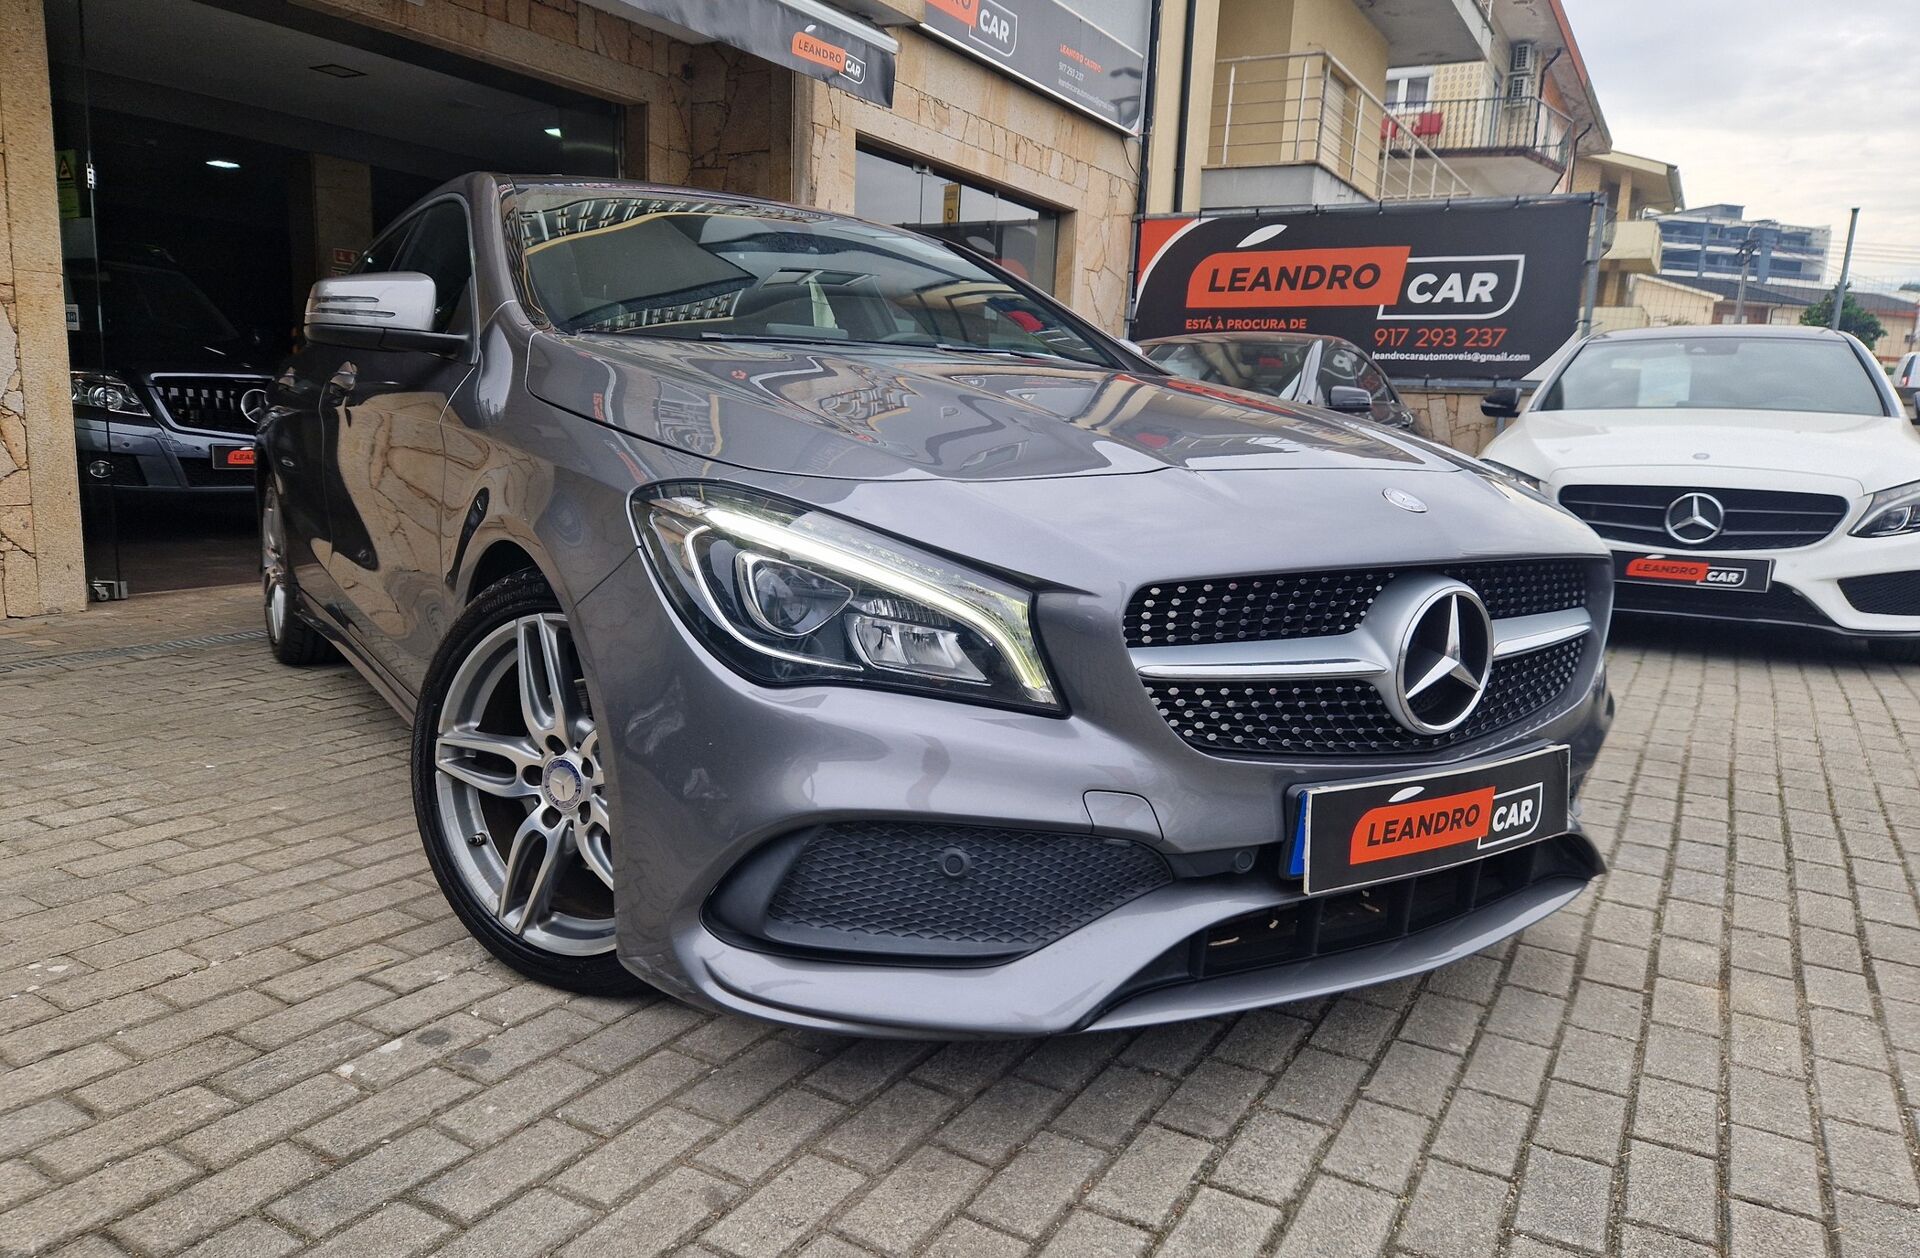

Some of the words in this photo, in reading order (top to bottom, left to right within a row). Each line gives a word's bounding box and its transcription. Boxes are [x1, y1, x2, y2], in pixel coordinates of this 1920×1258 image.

[979, 8, 1010, 44] CAR
[798, 39, 842, 64] LEANDRO
[845, 60, 861, 78] CAR
[1207, 262, 1382, 293] LEANDRO
[1406, 271, 1499, 304] CAR
[1185, 317, 1213, 330] ESTÁ
[1216, 315, 1225, 330] À
[1226, 318, 1287, 330] PROCURA
[1289, 318, 1307, 330] DE
[1374, 327, 1408, 347] 917
[1414, 327, 1457, 347] 293
[1463, 327, 1508, 347] 237
[1372, 351, 1531, 363] leandrocarautomoveis@gmail.com
[1636, 563, 1698, 576] LEANDRO
[1706, 570, 1740, 583] CAR
[1367, 803, 1481, 848] LEANDRO
[1492, 799, 1534, 832] CAR
